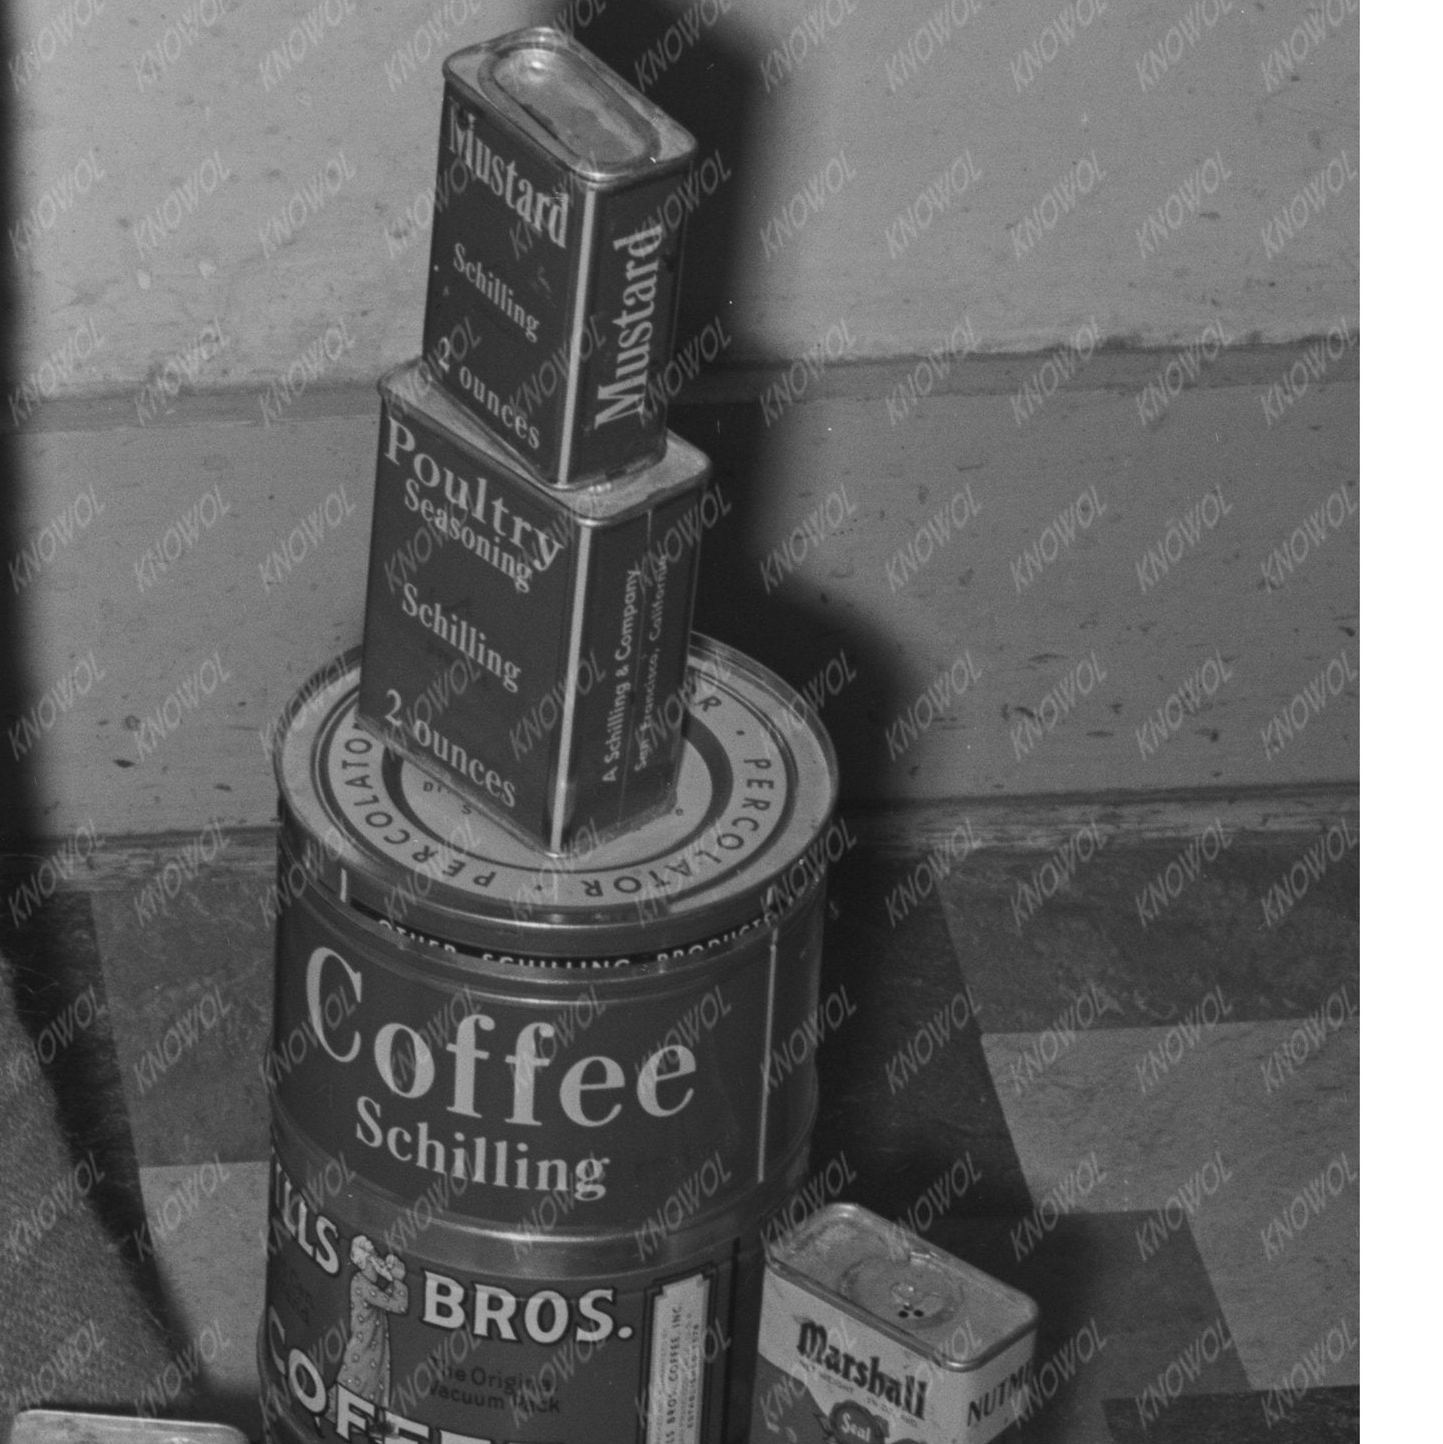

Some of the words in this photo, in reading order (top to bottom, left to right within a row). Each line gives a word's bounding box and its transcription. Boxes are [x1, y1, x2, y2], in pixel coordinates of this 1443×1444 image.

[447, 102, 570, 249] Mustard
[452, 241, 541, 344] Schilling
[593, 222, 664, 431] Mustard
[437, 336, 452, 372] 2
[458, 365, 542, 452] ounces
[383, 414, 565, 573] Poultry
[403, 477, 533, 594] Seasoning
[401, 582, 523, 694] Schilling
[614, 569, 643, 662] Company
[385, 688, 405, 727] 2
[414, 720, 517, 808] ounces
[603, 680, 632, 765] Schilling
[341, 722, 498, 889] PERCOLATO
[581, 757, 777, 899] PERCOLATOR
[305, 946, 697, 1128] Coffee
[355, 1095, 611, 1203] Schilling
[421, 1269, 635, 1346] BROS.
